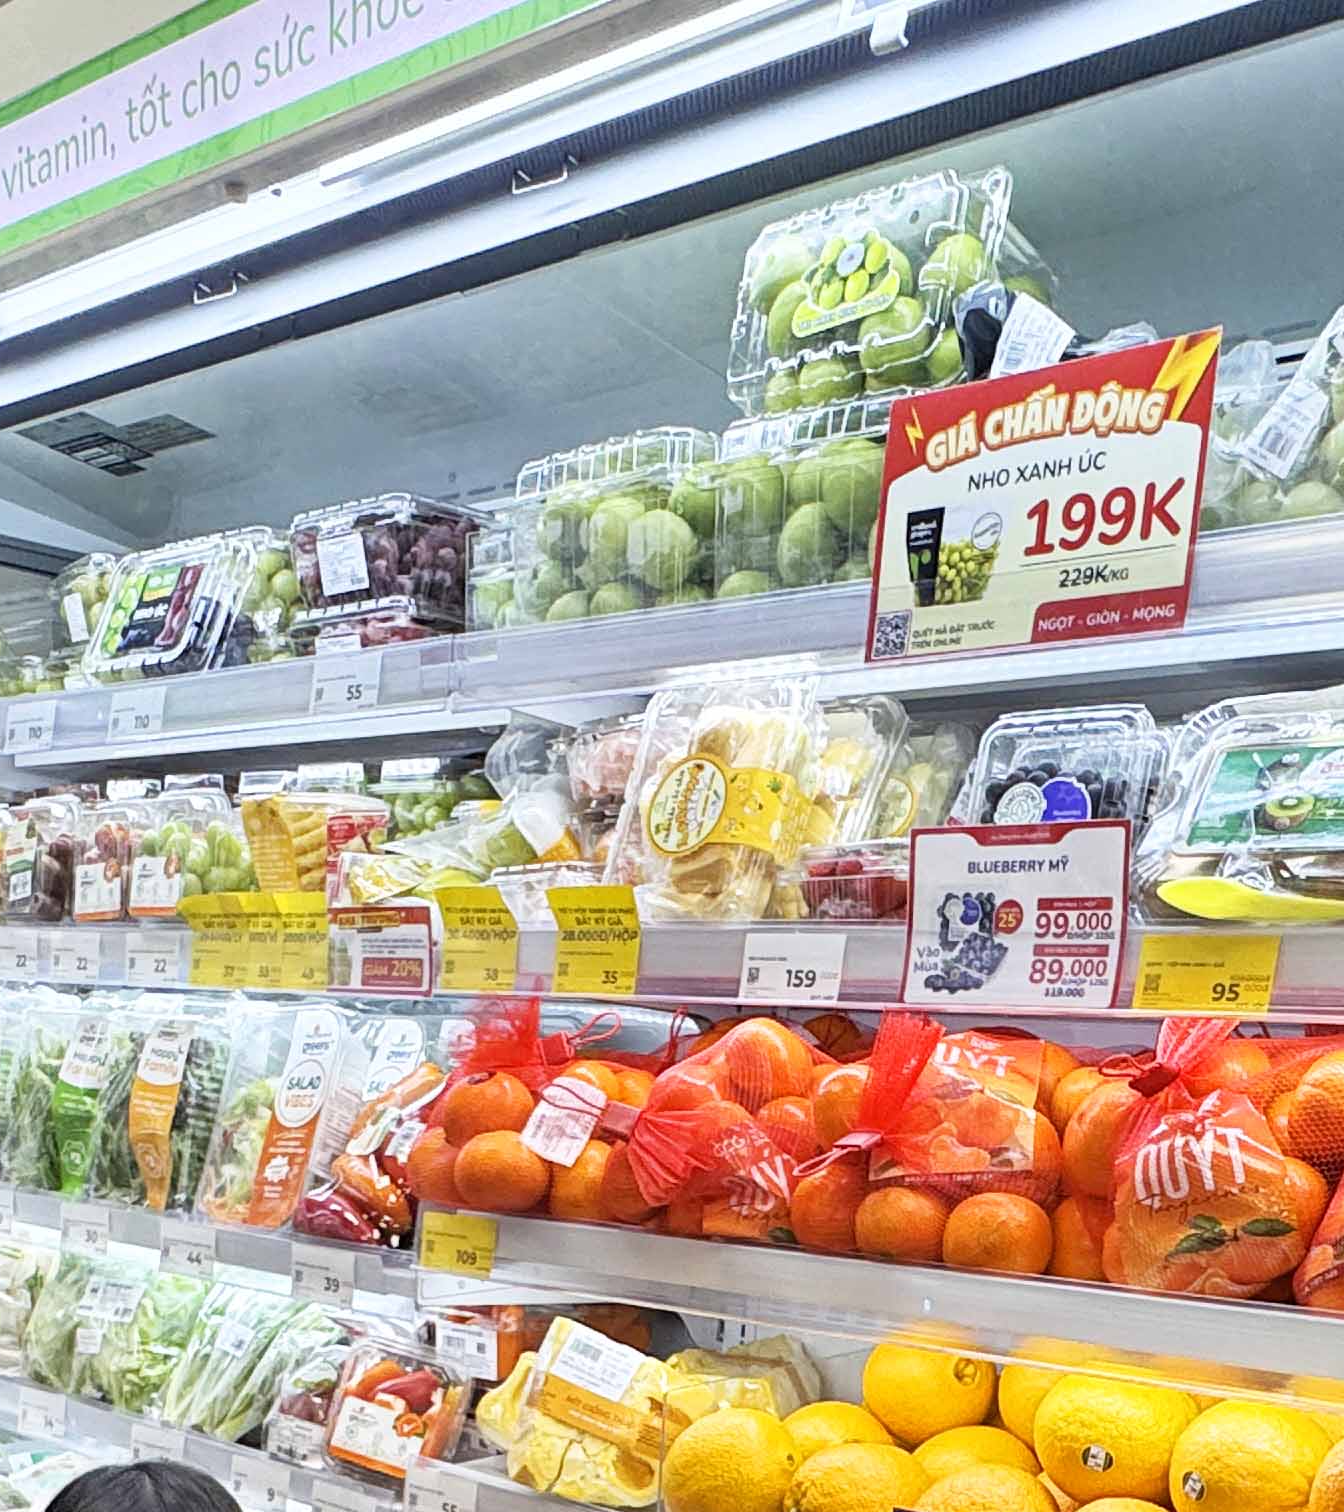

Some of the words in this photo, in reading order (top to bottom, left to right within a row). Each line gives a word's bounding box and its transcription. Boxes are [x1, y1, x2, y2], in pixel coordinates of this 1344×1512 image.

[1, 116, 116, 201] vitamin,
[125, 73, 171, 144] tốt
[182, 59, 241, 120] cho
[254, 14, 315, 89] sức
[925, 411, 978, 468] GIÁ
[984, 385, 1069, 448] CHẤN
[1070, 380, 1168, 435] ĐỘNG
[968, 469, 1010, 493] NHO
[1016, 456, 1072, 485] XANH
[1079, 449, 1107, 473] ÚC
[1023, 478, 1185, 557] 199K
[1059, 564, 1129, 588] 229K/KG
[1038, 613, 1075, 633] NGỌT
[1087, 608, 1120, 627] GIÒN
[1132, 604, 1176, 623] MỌNG
[346, 684, 363, 700] 55
[967, 859, 1044, 874] BLUEBERRY
[1049, 855, 1069, 873] MỸ
[997, 914, 1017, 928] 25
[1034, 912, 1112, 939] 99.000
[154, 959, 167, 973] 22
[1029, 959, 1107, 984] 89.000
[602, 970, 618, 984] 35
[786, 968, 816, 988] 159
[1212, 982, 1240, 1002] 95
[187, 1251, 203, 1266] 44
[456, 1249, 477, 1265] 109
[324, 1278, 339, 1292] 39
